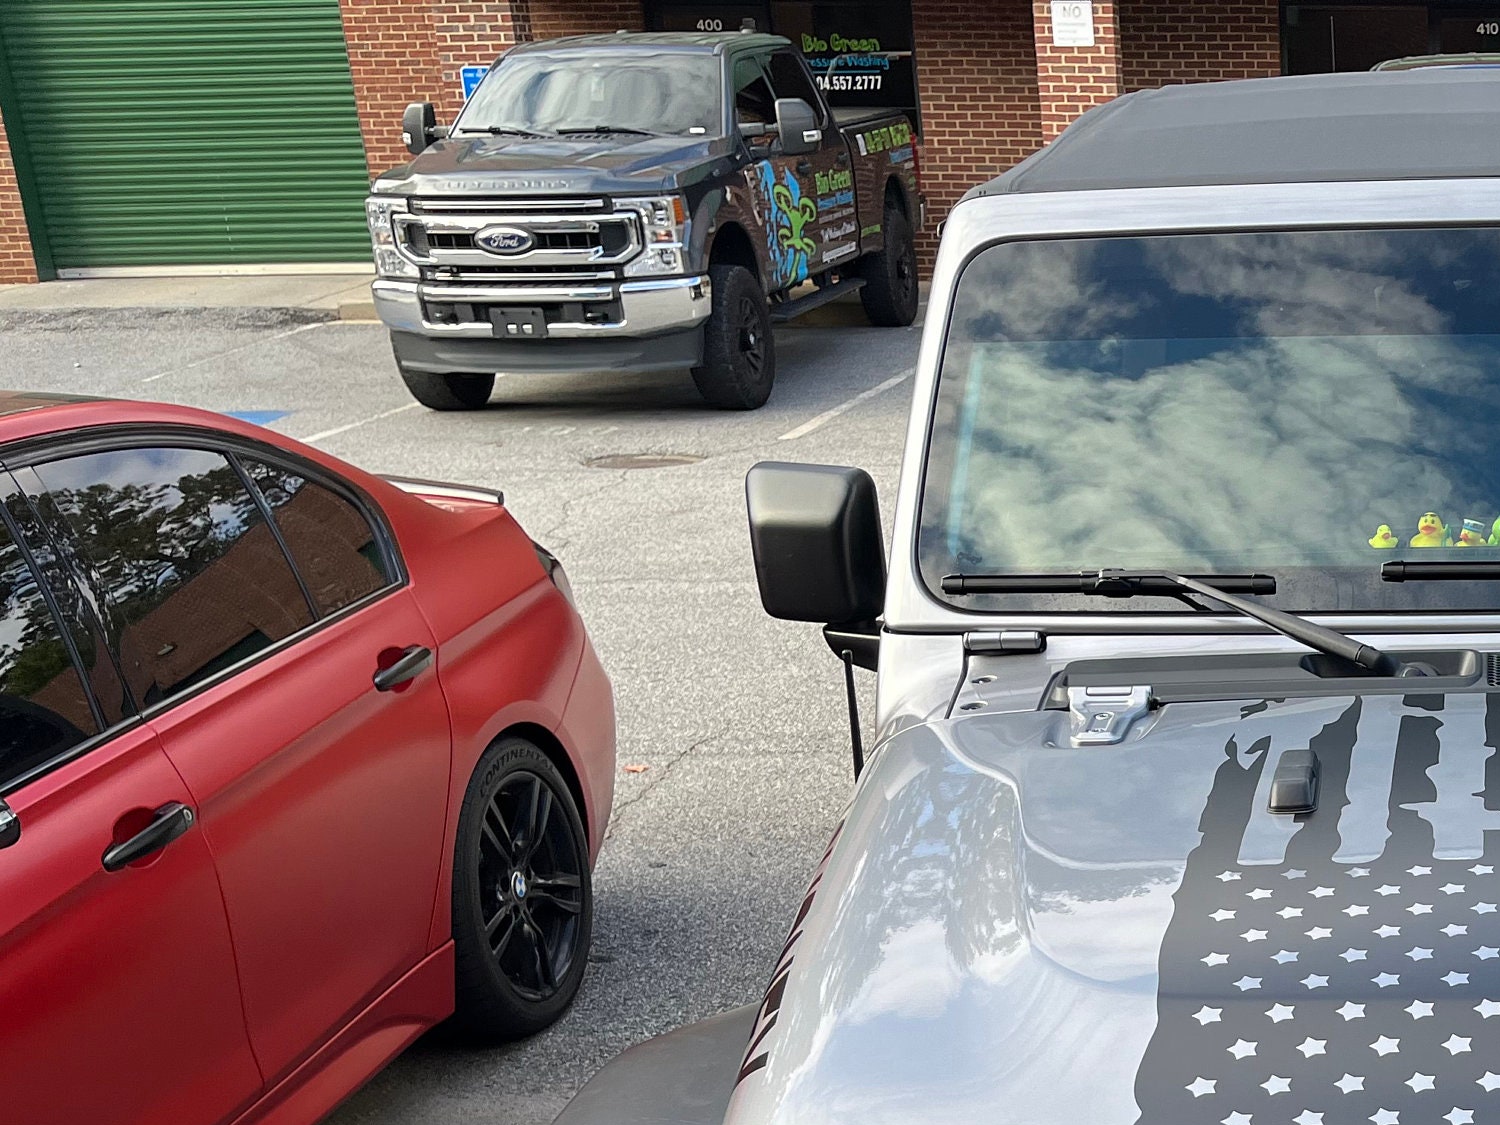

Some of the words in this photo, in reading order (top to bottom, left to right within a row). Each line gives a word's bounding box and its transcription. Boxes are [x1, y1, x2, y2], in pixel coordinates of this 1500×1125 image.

[1062, 5, 1081, 18] NO
[696, 19, 723, 31] 400
[1476, 22, 1499, 35] 410
[801, 32, 827, 52] Bio
[829, 33, 880, 52] Green
[490, 234, 519, 247] Ford
